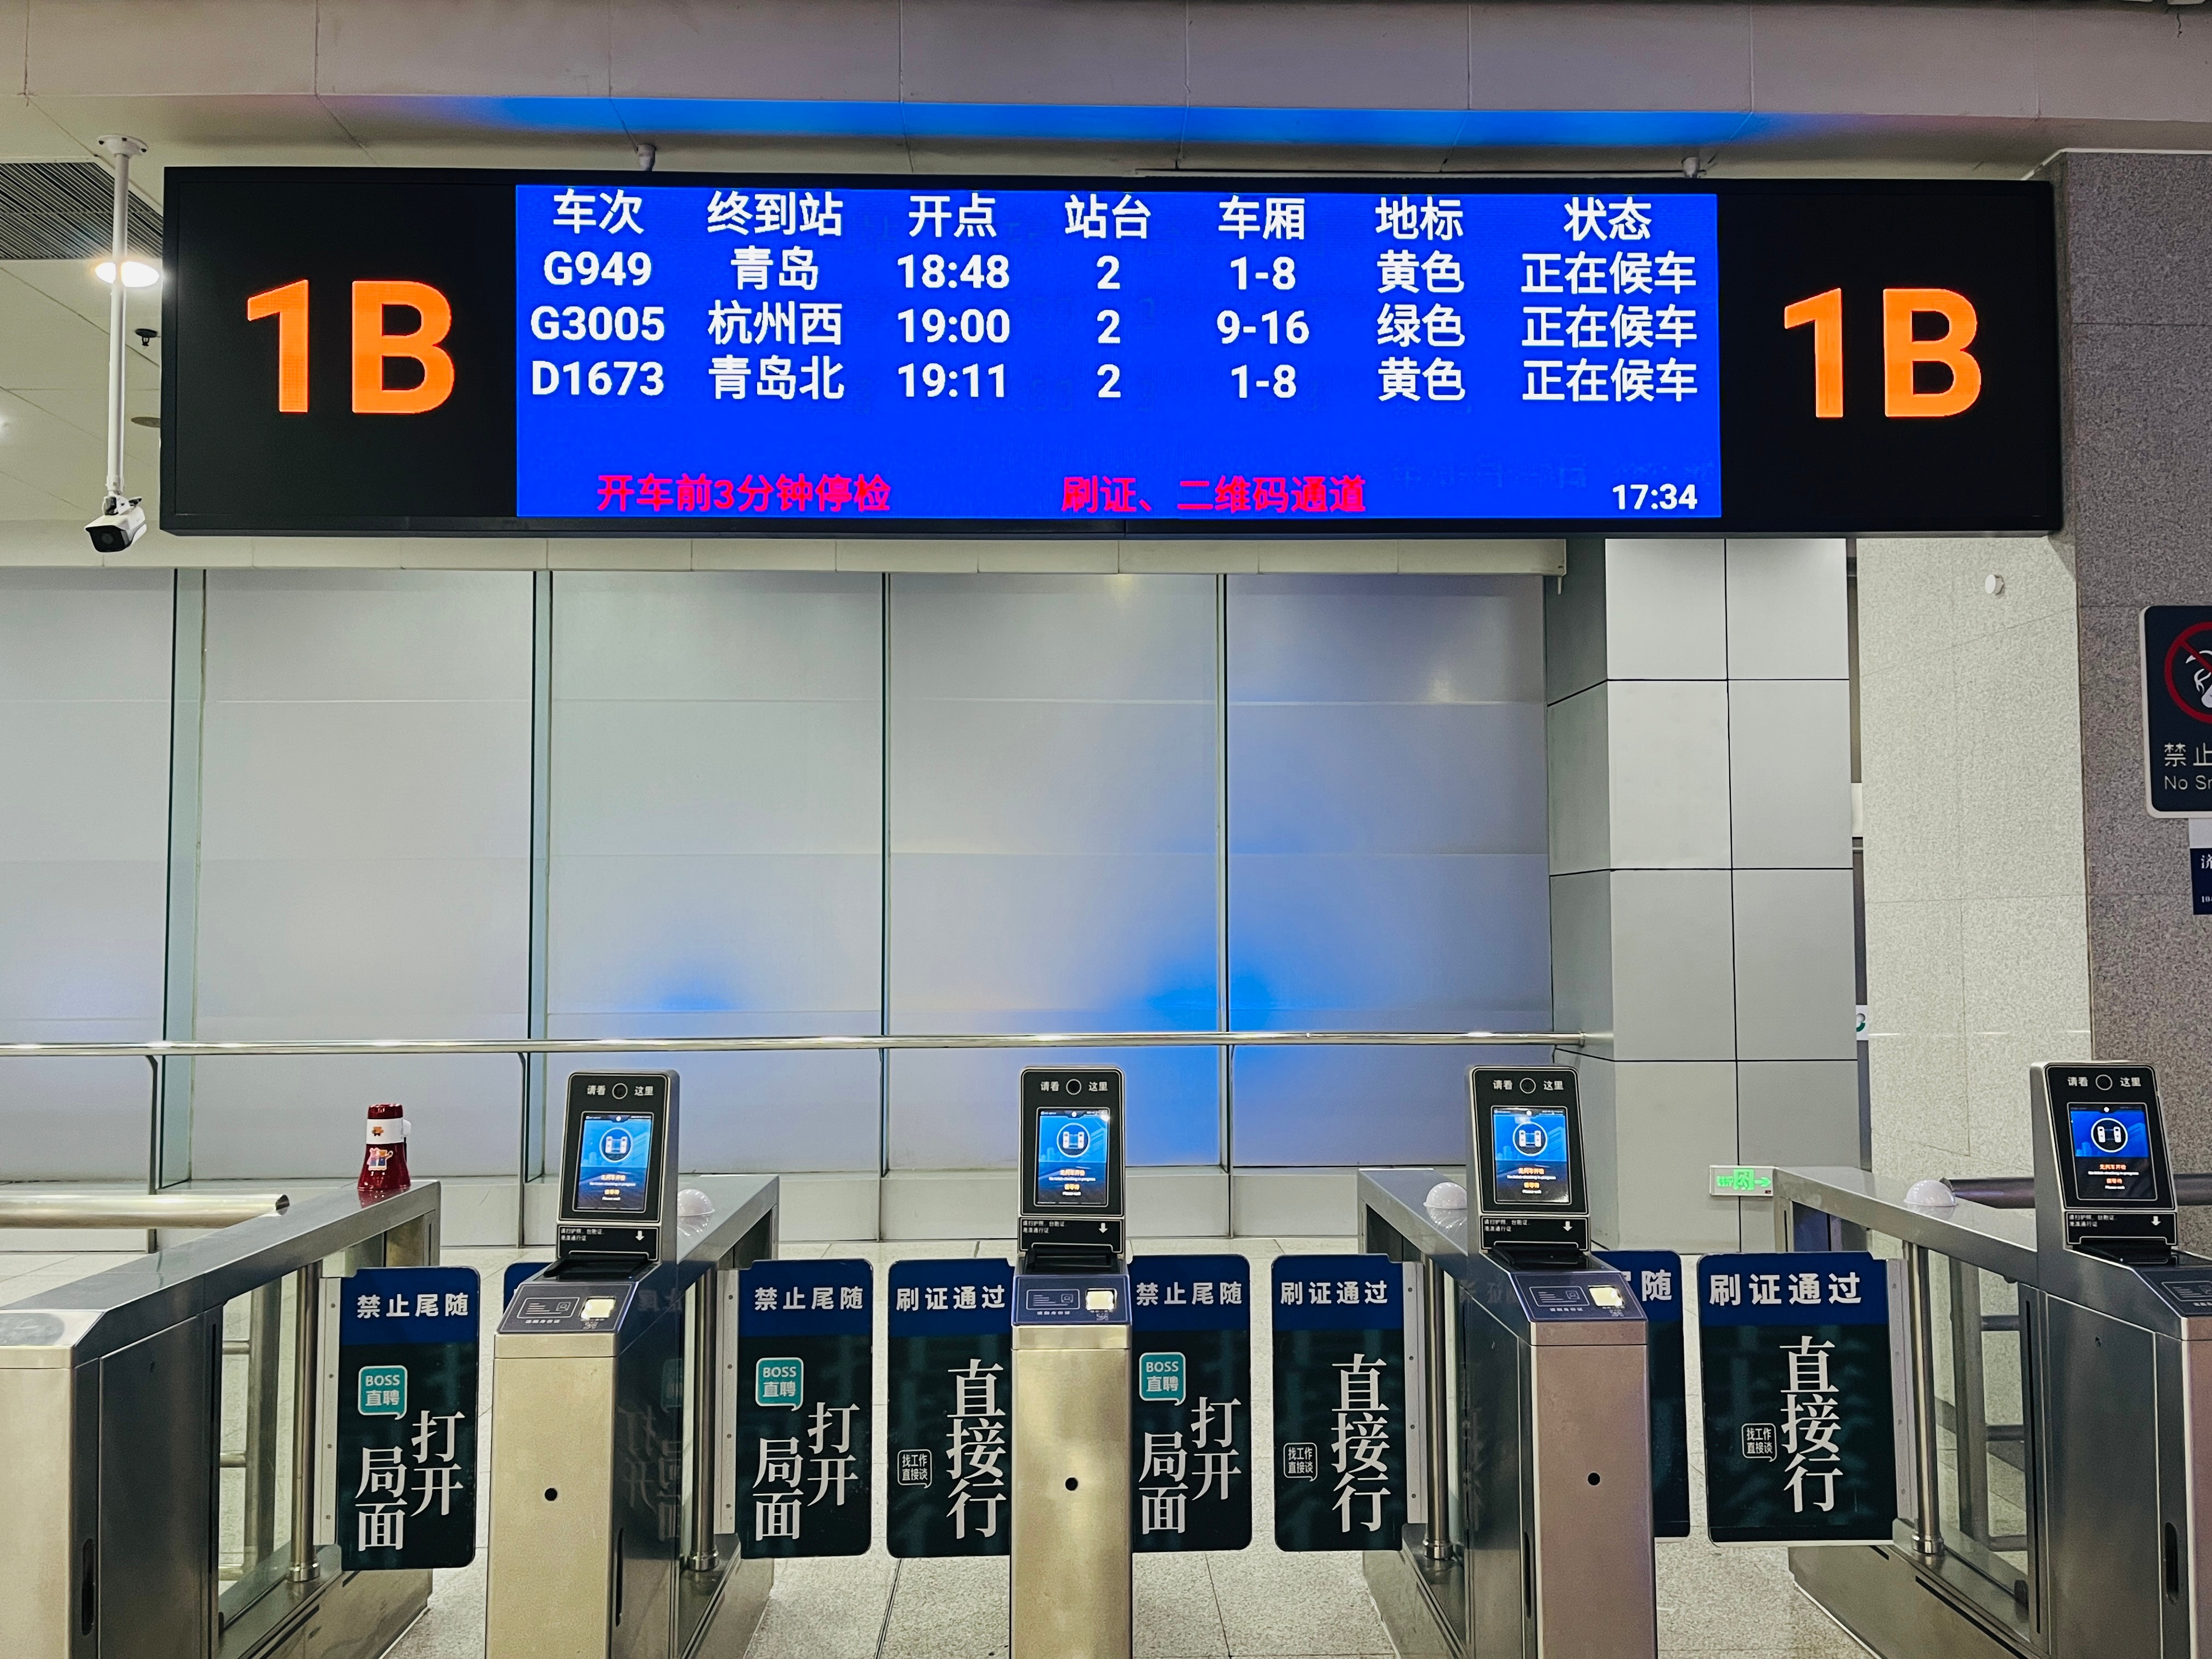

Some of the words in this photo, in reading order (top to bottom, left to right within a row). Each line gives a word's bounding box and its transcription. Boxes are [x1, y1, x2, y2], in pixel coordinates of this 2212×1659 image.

[554, 189, 644, 234] 车次
[708, 191, 843, 236] 终到站
[909, 193, 996, 237] 开点
[1065, 194, 1150, 239] 站台
[1218, 195, 1305, 239] 车厢
[1375, 196, 1463, 240] 地标
[1564, 197, 1651, 240] 状态
[544, 251, 651, 285] G949
[731, 245, 818, 290] 青岛
[898, 255, 1009, 288] 18:48
[1097, 256, 1120, 289] 2
[1231, 257, 1295, 290] 1-8
[1377, 250, 1464, 293] 黄色
[1521, 250, 1696, 294] 正在候车
[531, 306, 664, 341] G3005
[708, 300, 842, 345] 杭州西
[899, 309, 1009, 342] 19:00
[1097, 310, 1120, 343] 2
[1217, 311, 1309, 343] 9-16
[1378, 303, 1465, 347] 绿色
[1522, 304, 1697, 347] 正在候车
[247, 279, 454, 414] 1B
[1784, 288, 1981, 417] 1B
[533, 361, 663, 396] D1673
[709, 354, 844, 399] 青岛北
[899, 363, 1003, 397] 19:11
[1097, 364, 1120, 397] 2
[1232, 365, 1296, 398] 1-8
[1378, 357, 1465, 400] 黄色
[1523, 358, 1697, 402] 正在候车
[597, 473, 890, 511] 开车前3分钟停检
[1062, 475, 1365, 513] 刷证、二维码通道
[1613, 484, 1697, 509] 17:34
[2165, 776, 2187, 789] No
[588, 1085, 606, 1095] 请看
[634, 1086, 653, 1096] 这里
[1041, 1081, 1059, 1091] 请看
[1089, 1082, 1108, 1091] 这里
[1493, 1080, 1513, 1090] 请看
[1543, 1081, 1564, 1090] 这里
[2068, 1077, 2087, 1086] 请看
[2120, 1077, 2141, 1087] 这里
[755, 1286, 862, 1310] 禁止尾随
[896, 1285, 1005, 1311] 刷证通过
[1137, 1282, 1242, 1306] 禁止尾随
[1281, 1280, 1387, 1305] 刷证通过
[1622, 1271, 1672, 1301] 随
[1709, 1272, 1861, 1306] 刷证通过
[358, 1293, 468, 1318] 禁止尾随
[764, 1367, 795, 1377] BOSS
[1147, 1362, 1178, 1372] BOSS
[366, 1375, 399, 1386] BOSS
[764, 1381, 795, 1397] 直聘
[1148, 1376, 1178, 1391] 直聘
[366, 1390, 398, 1406] 直聘
[1747, 1428, 1771, 1440] 找工作
[1780, 1336, 1843, 1512] 直接行
[808, 1402, 860, 1506] 打开
[946, 1359, 1006, 1539] 直接行
[1191, 1397, 1241, 1500] 打开
[1289, 1447, 1312, 1460] 找工作
[1331, 1353, 1391, 1532] 直接行
[1747, 1442, 1773, 1453] 直接谈
[411, 1410, 465, 1516] 打开
[902, 1454, 927, 1467] 找工作
[1289, 1462, 1313, 1473] 直接谈
[902, 1468, 927, 1480] 直接谈
[1139, 1431, 1188, 1534] 局面
[356, 1446, 407, 1551] 局面
[753, 1437, 803, 1541] 局面
